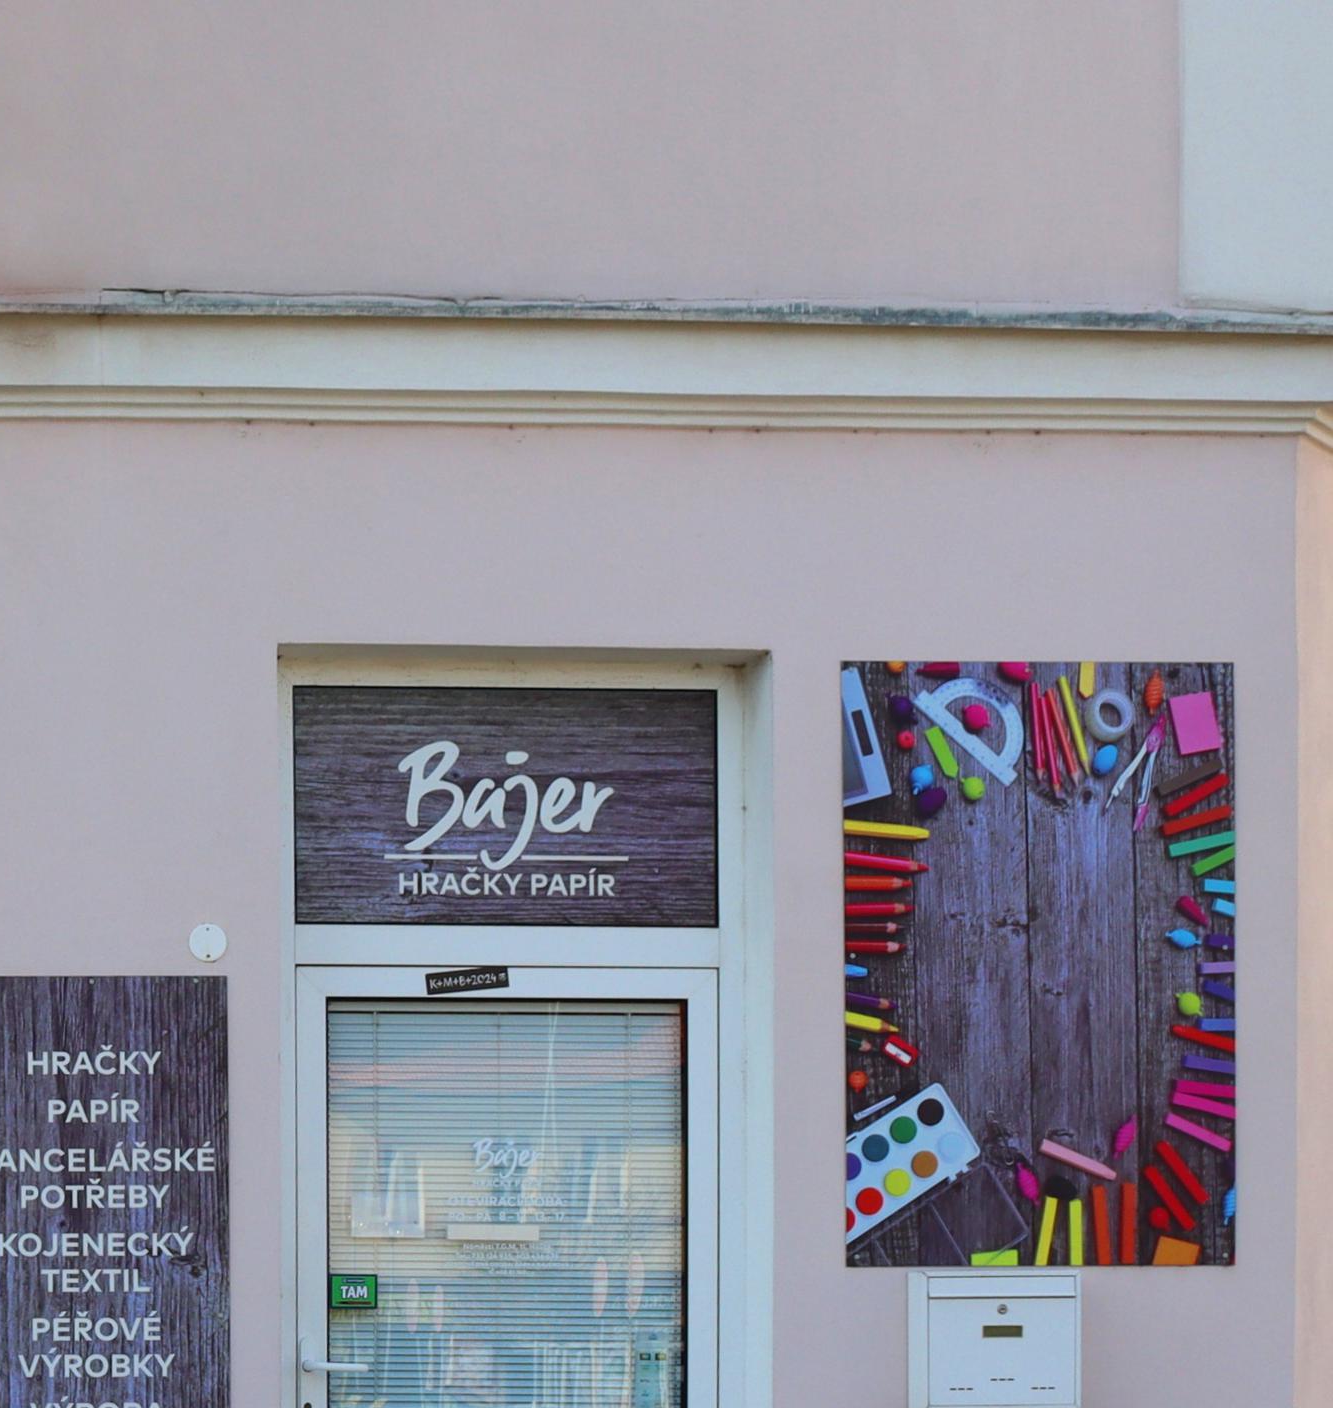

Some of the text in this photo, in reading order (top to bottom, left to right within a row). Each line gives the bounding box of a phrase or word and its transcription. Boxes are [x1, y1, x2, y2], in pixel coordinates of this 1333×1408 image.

[398, 740, 615, 870] Bajer
[399, 867, 615, 896] HRAČKY PAPÍR
[27, 1044, 162, 1075] HRAČKY
[47, 1092, 140, 1123] PAPÍR
[20, 1178, 170, 1209] POTŘEBY
[40, 1269, 151, 1292] TEXTIL
[340, 1286, 368, 1298] TAM
[31, 1311, 162, 1341] PÉŘOVÉ
[18, 1347, 176, 1378] VÝROBKY
